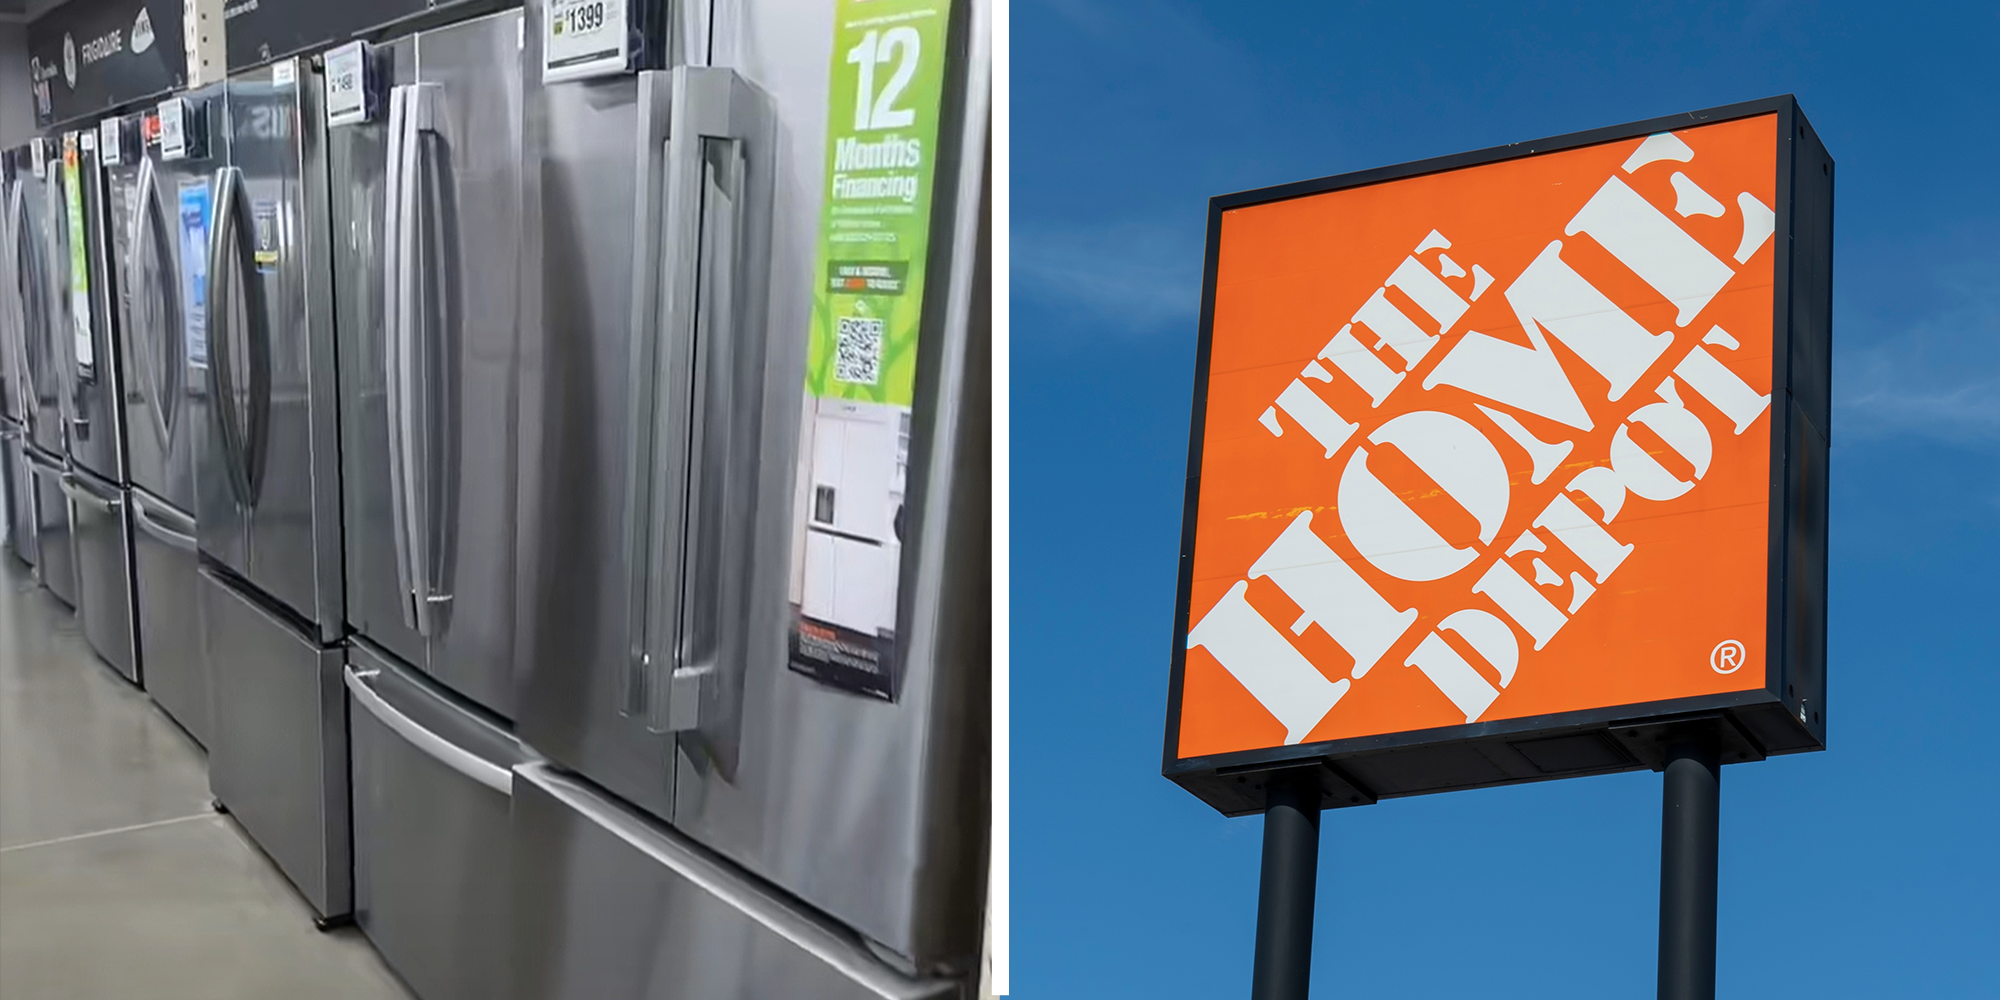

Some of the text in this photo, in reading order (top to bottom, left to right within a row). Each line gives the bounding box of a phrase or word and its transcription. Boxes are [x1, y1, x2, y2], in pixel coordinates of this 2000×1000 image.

[834, 133, 920, 172] Months
[847, 26, 921, 131] 12
[831, 171, 919, 202] Financing
[1258, 229, 1495, 459] THE
[1187, 132, 1776, 746] HOME
[1404, 324, 1772, 724] DEPOT
